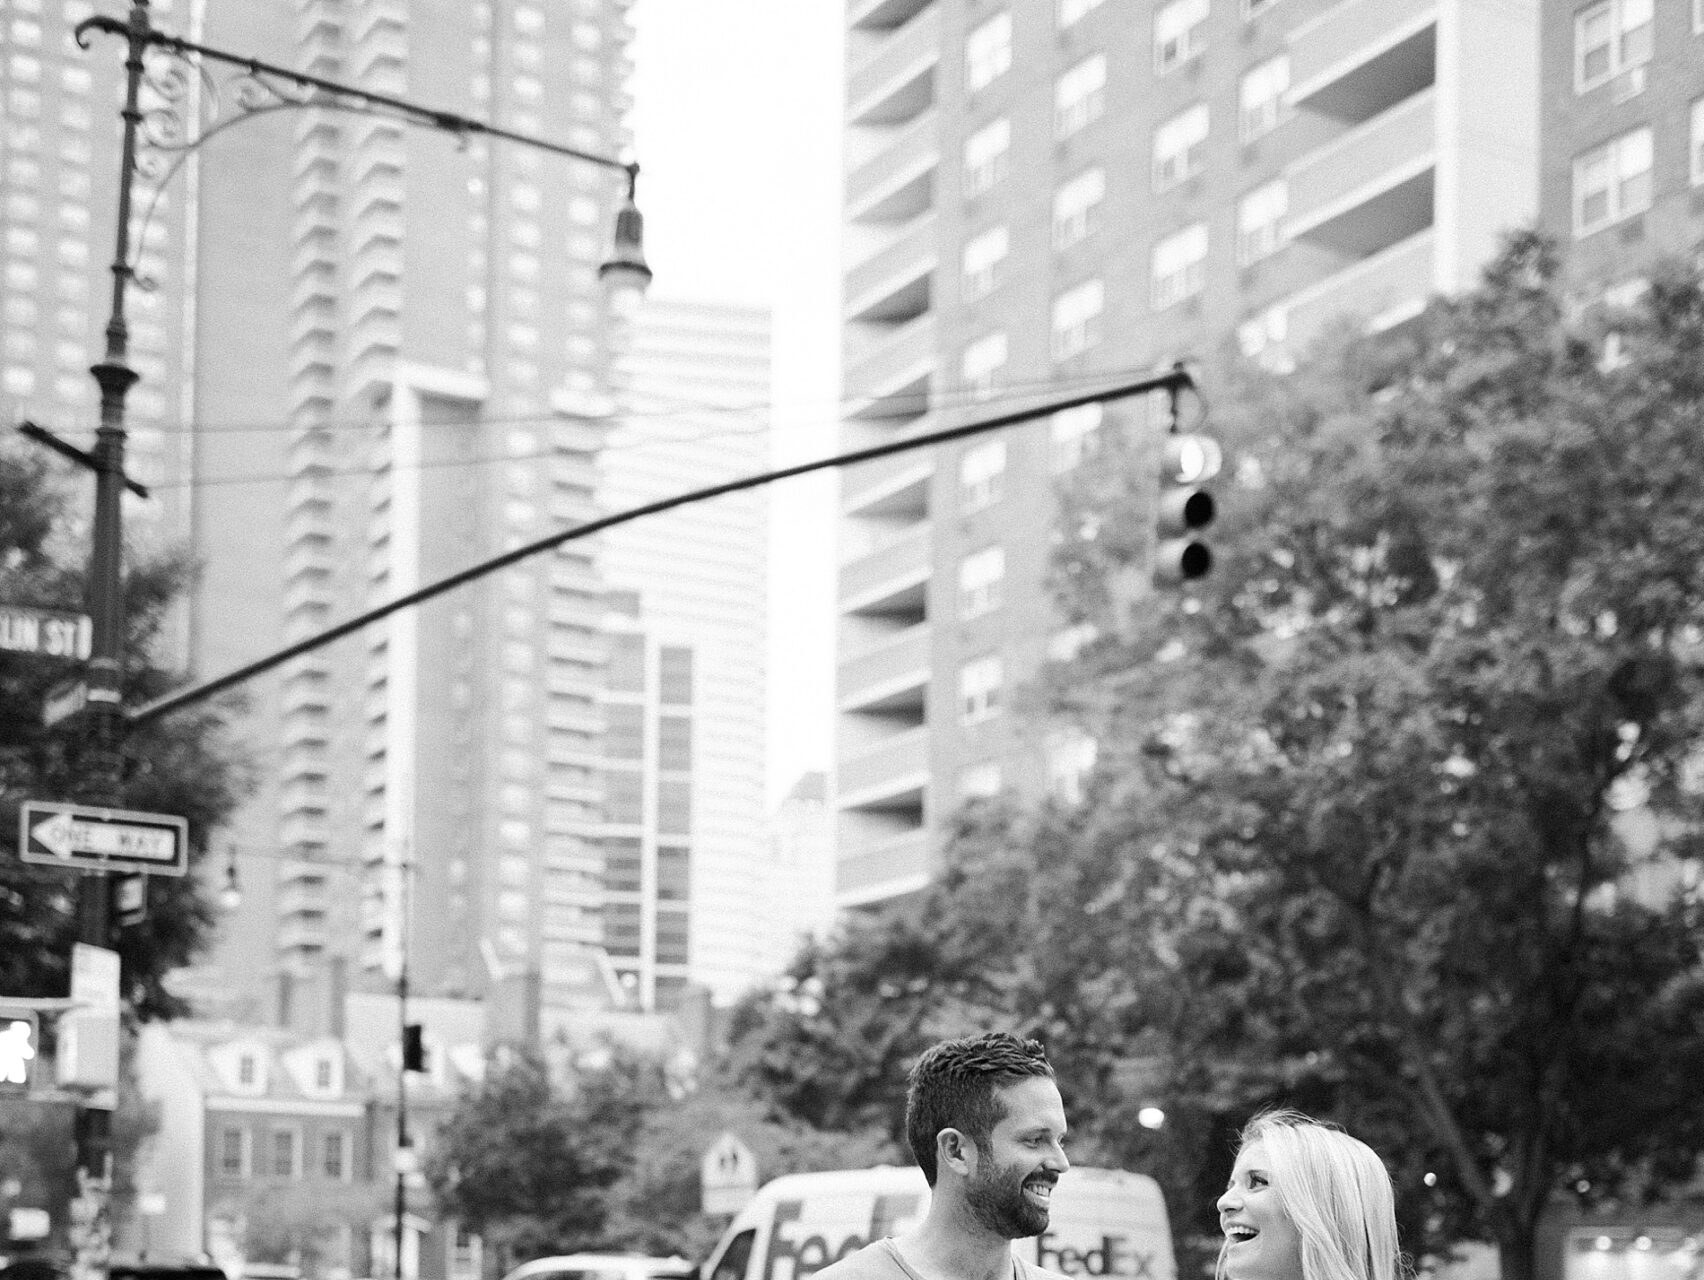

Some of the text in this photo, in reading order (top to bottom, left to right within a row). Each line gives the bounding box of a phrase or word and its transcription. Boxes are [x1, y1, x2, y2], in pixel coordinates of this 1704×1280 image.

[0, 614, 75, 656] LIN ST
[1037, 1232, 1154, 1278] FedEx
